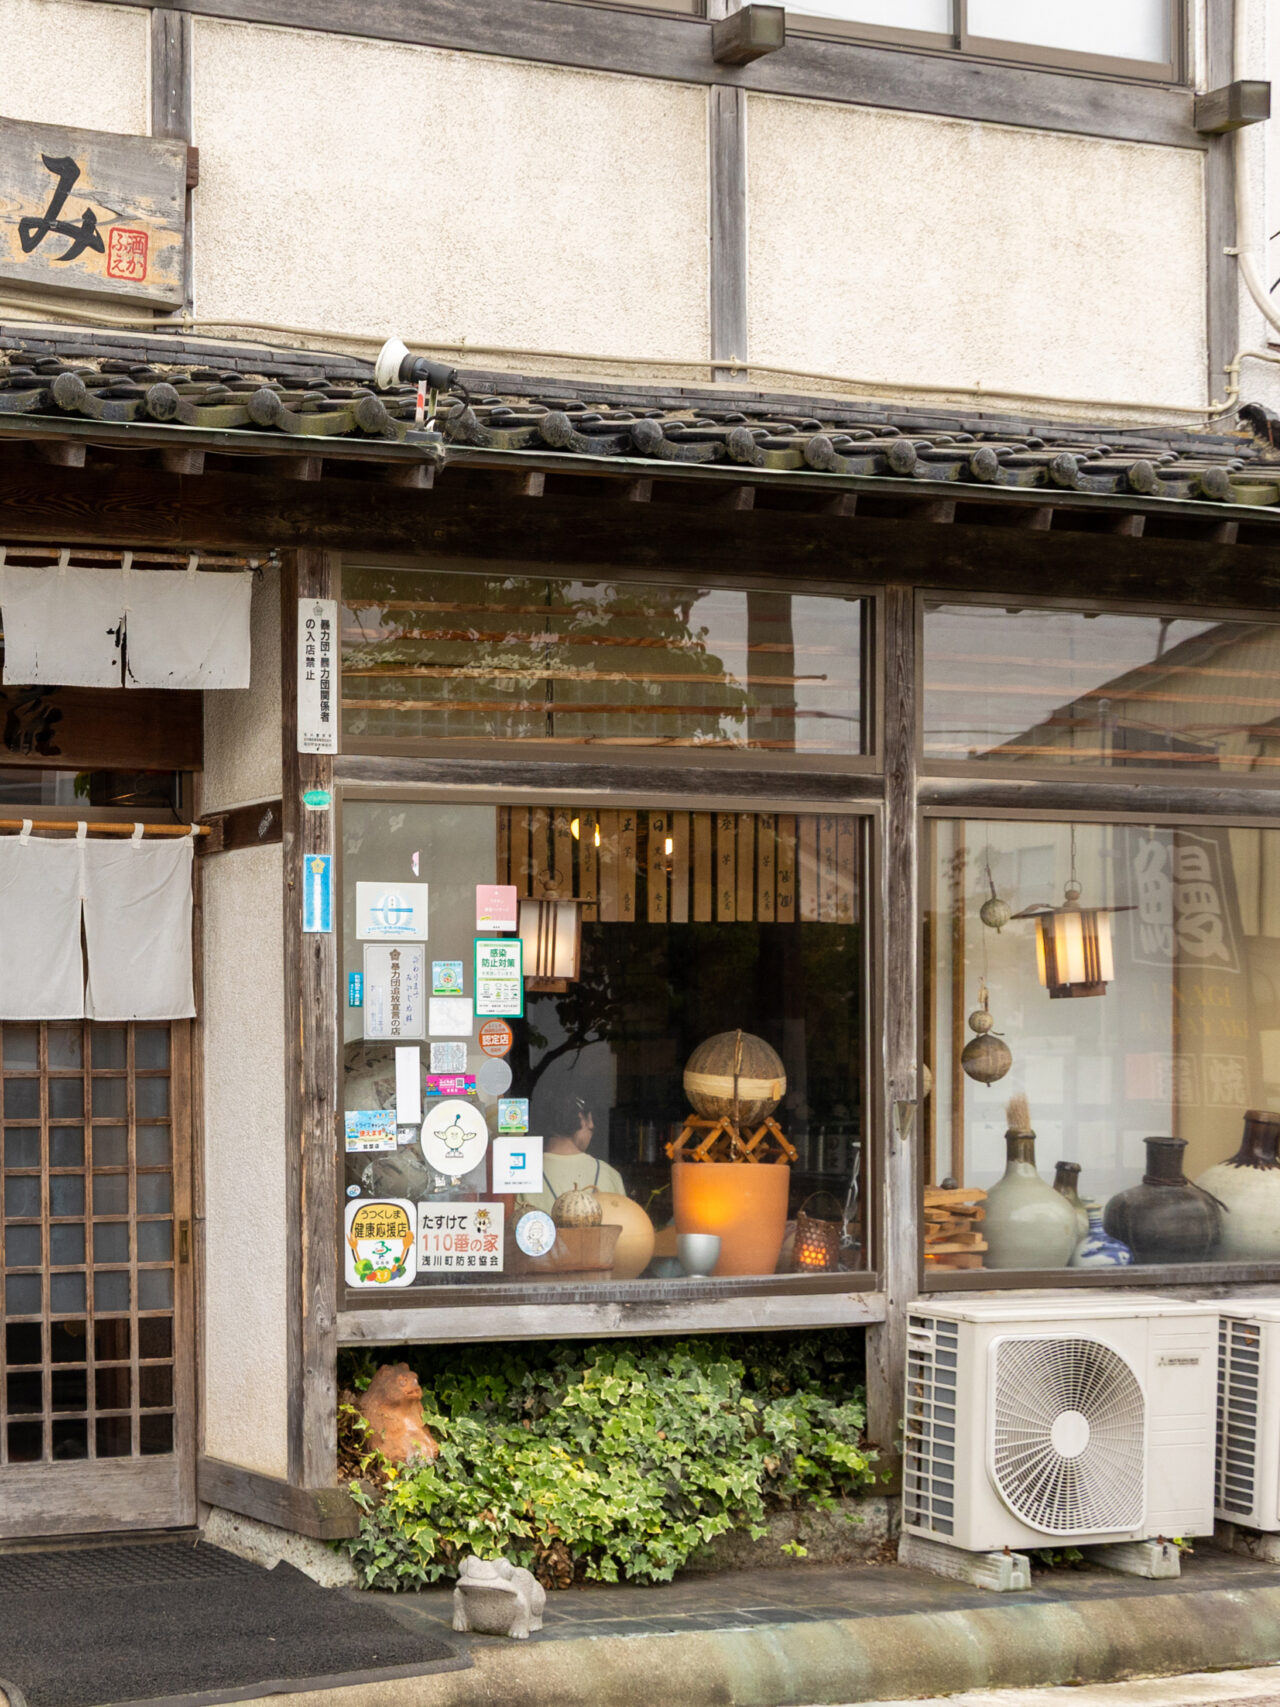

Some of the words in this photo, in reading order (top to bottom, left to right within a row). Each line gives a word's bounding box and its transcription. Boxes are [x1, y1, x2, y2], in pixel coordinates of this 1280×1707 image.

[305, 618, 316, 681] の入店禁止
[320, 619, 331, 723] 暴力団・暴力団関係者
[490, 948, 507, 957] 感染
[481, 958, 515, 967] 防止対策
[482, 1034, 509, 1046] 認定店
[361, 1209, 402, 1219] うつくしま
[422, 1214, 468, 1230] たすけて
[354, 1222, 407, 1238] 健康応援店
[422, 1233, 499, 1252] 110番の家
[421, 1255, 499, 1266] 浅川町防犯協会
